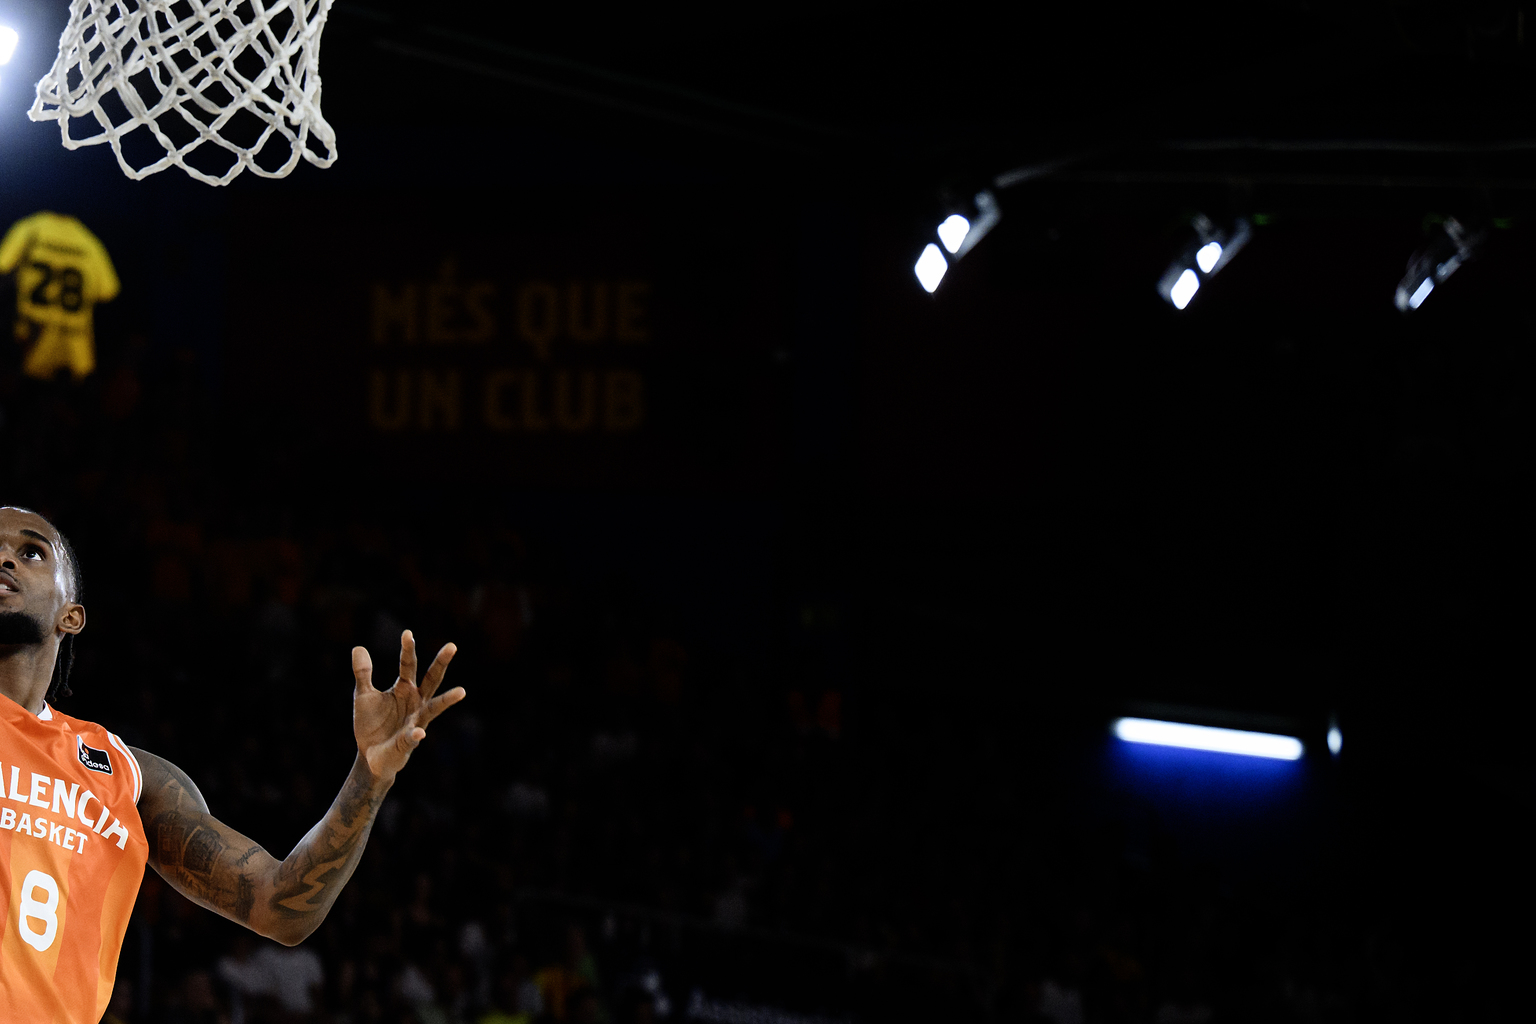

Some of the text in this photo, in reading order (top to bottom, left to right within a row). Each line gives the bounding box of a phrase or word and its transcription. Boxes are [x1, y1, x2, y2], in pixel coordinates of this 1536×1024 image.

[31, 262, 83, 313] 28
[368, 252, 653, 361] MÉS QUE
[368, 368, 647, 432] UN CLUB
[0, 807, 89, 854] BASKET
[19, 869, 59, 951] 8
